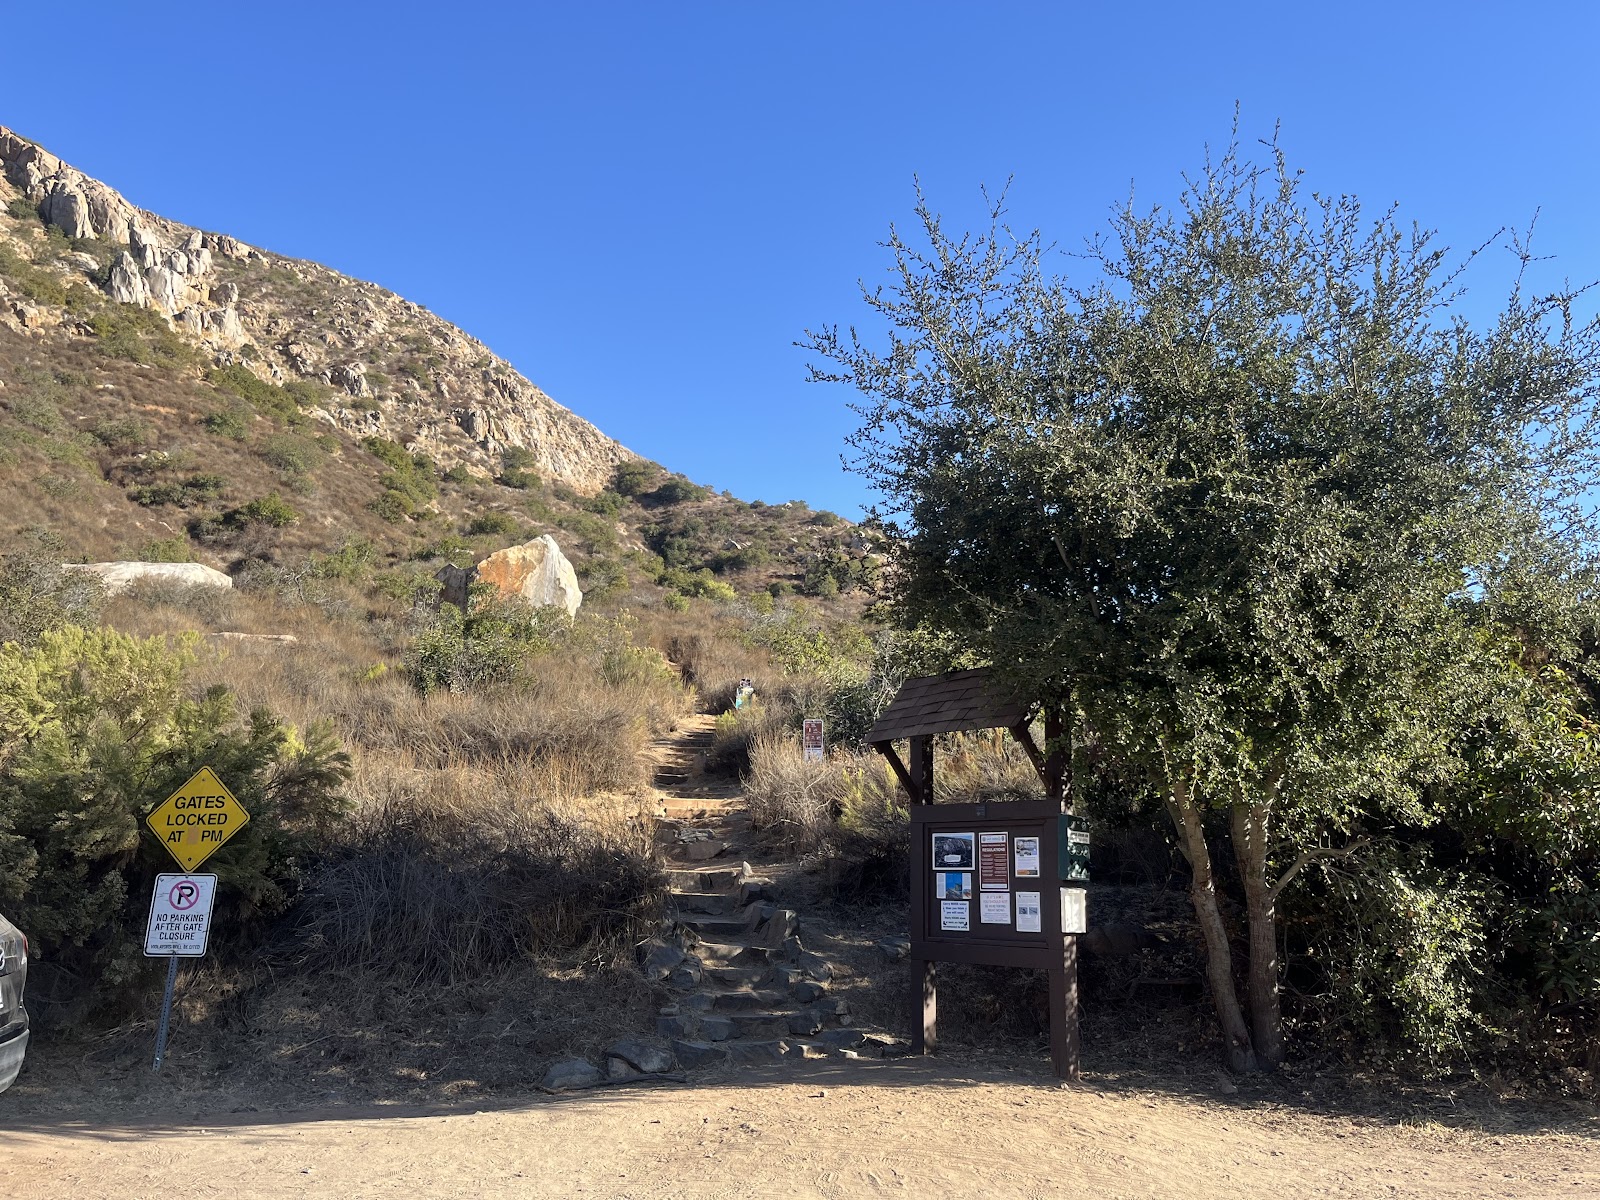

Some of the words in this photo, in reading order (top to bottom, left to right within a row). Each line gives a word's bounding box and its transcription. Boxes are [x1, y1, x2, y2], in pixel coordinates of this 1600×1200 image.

[174, 795, 226, 810] GATES
[166, 813, 228, 826] LOCKED
[166, 830, 185, 843] AT
[201, 830, 223, 842] PM
[156, 913, 168, 922] NO
[170, 913, 204, 922] PARKING
[154, 922, 180, 931] AFTER
[183, 922, 203, 931] GATE
[159, 931, 195, 941] CLOSURE
